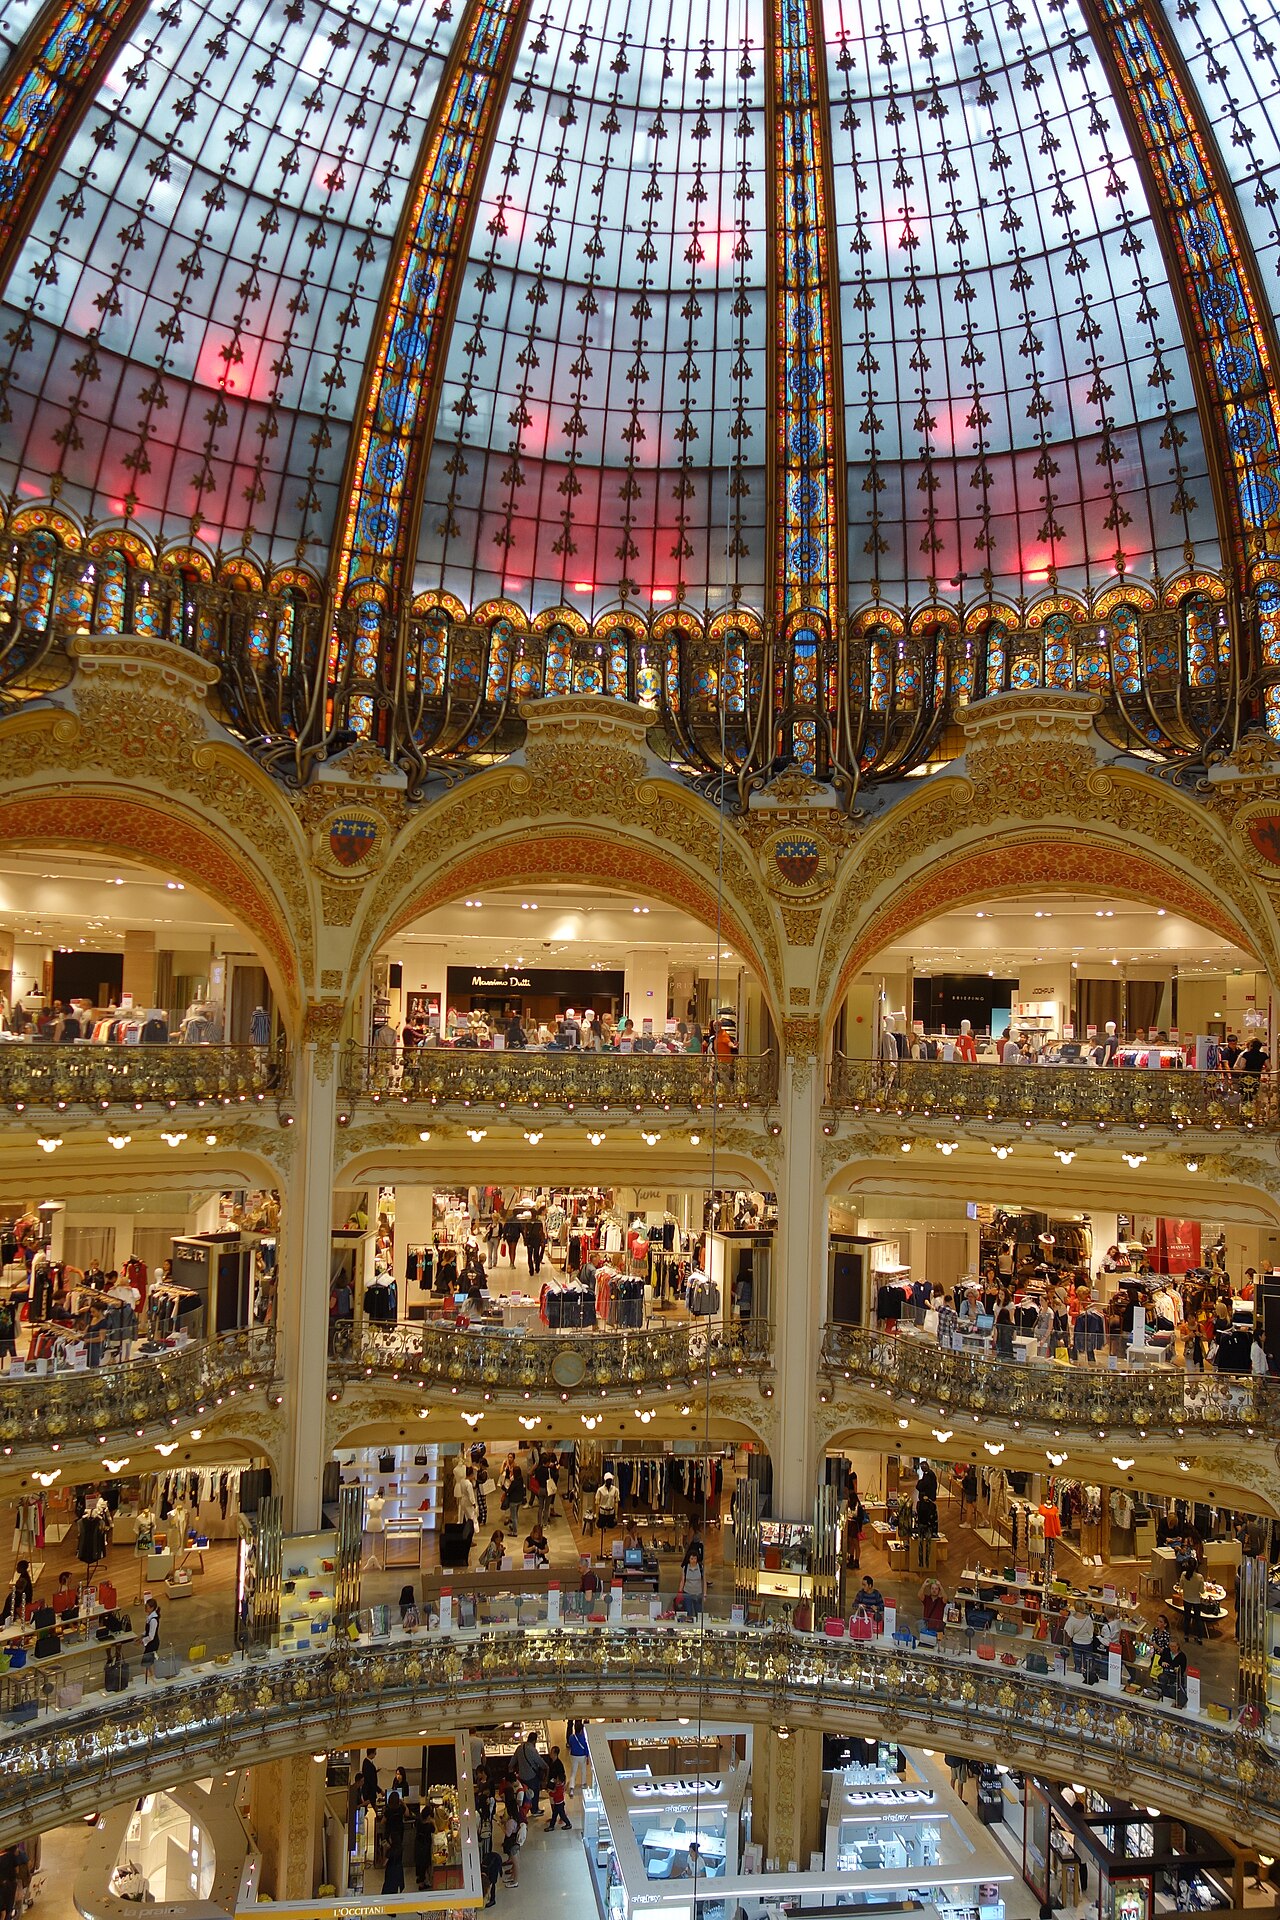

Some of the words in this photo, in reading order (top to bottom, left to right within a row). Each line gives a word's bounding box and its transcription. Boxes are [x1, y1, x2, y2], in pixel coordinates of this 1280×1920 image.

[472, 976, 508, 986] Massimo
[509, 977, 531, 987] Dutti
[632, 1779, 723, 1797] sisley
[847, 1788, 935, 1805] sisley
